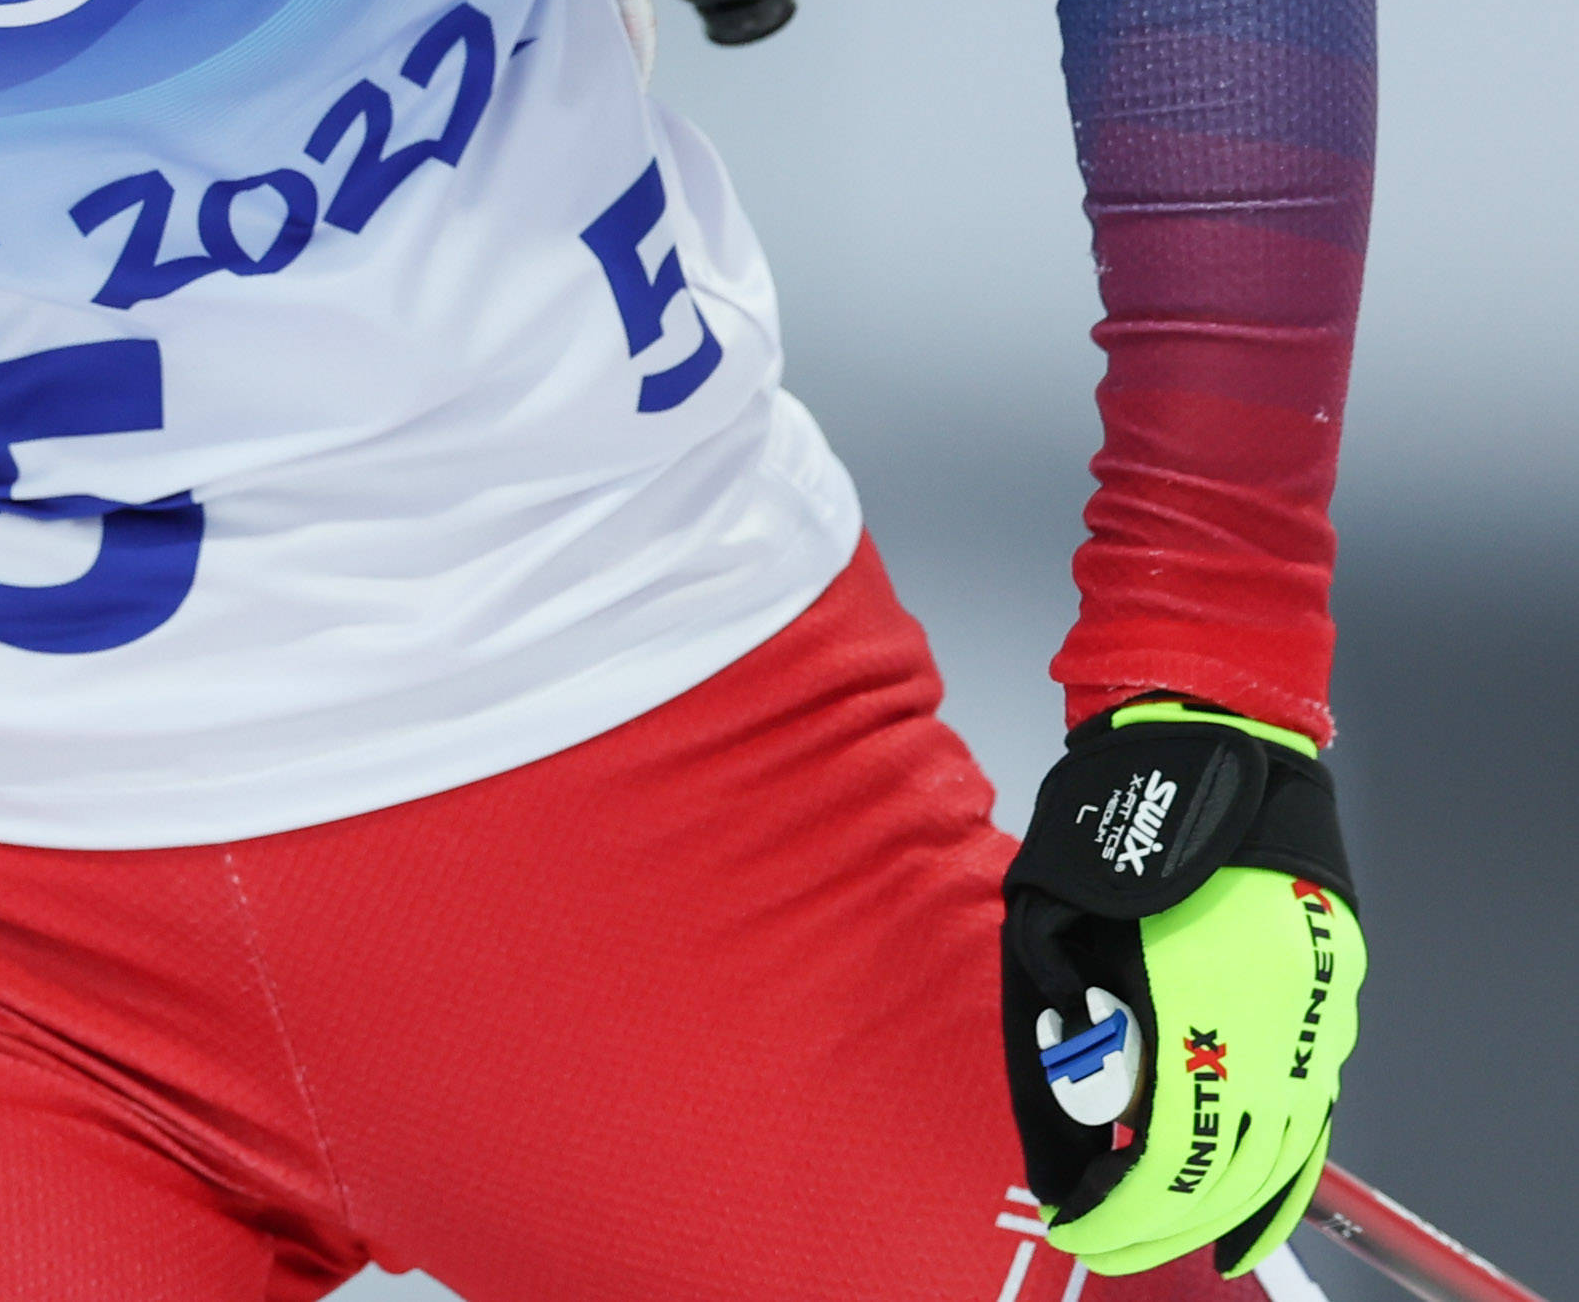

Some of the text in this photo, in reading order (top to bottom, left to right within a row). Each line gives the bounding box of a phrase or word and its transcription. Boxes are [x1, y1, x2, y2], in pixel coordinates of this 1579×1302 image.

[580, 156, 724, 413] 5
[1075, 804, 1100, 824] L
[1094, 789, 1123, 843] MEDIUM
[1102, 773, 1145, 861] X-FIT TCS
